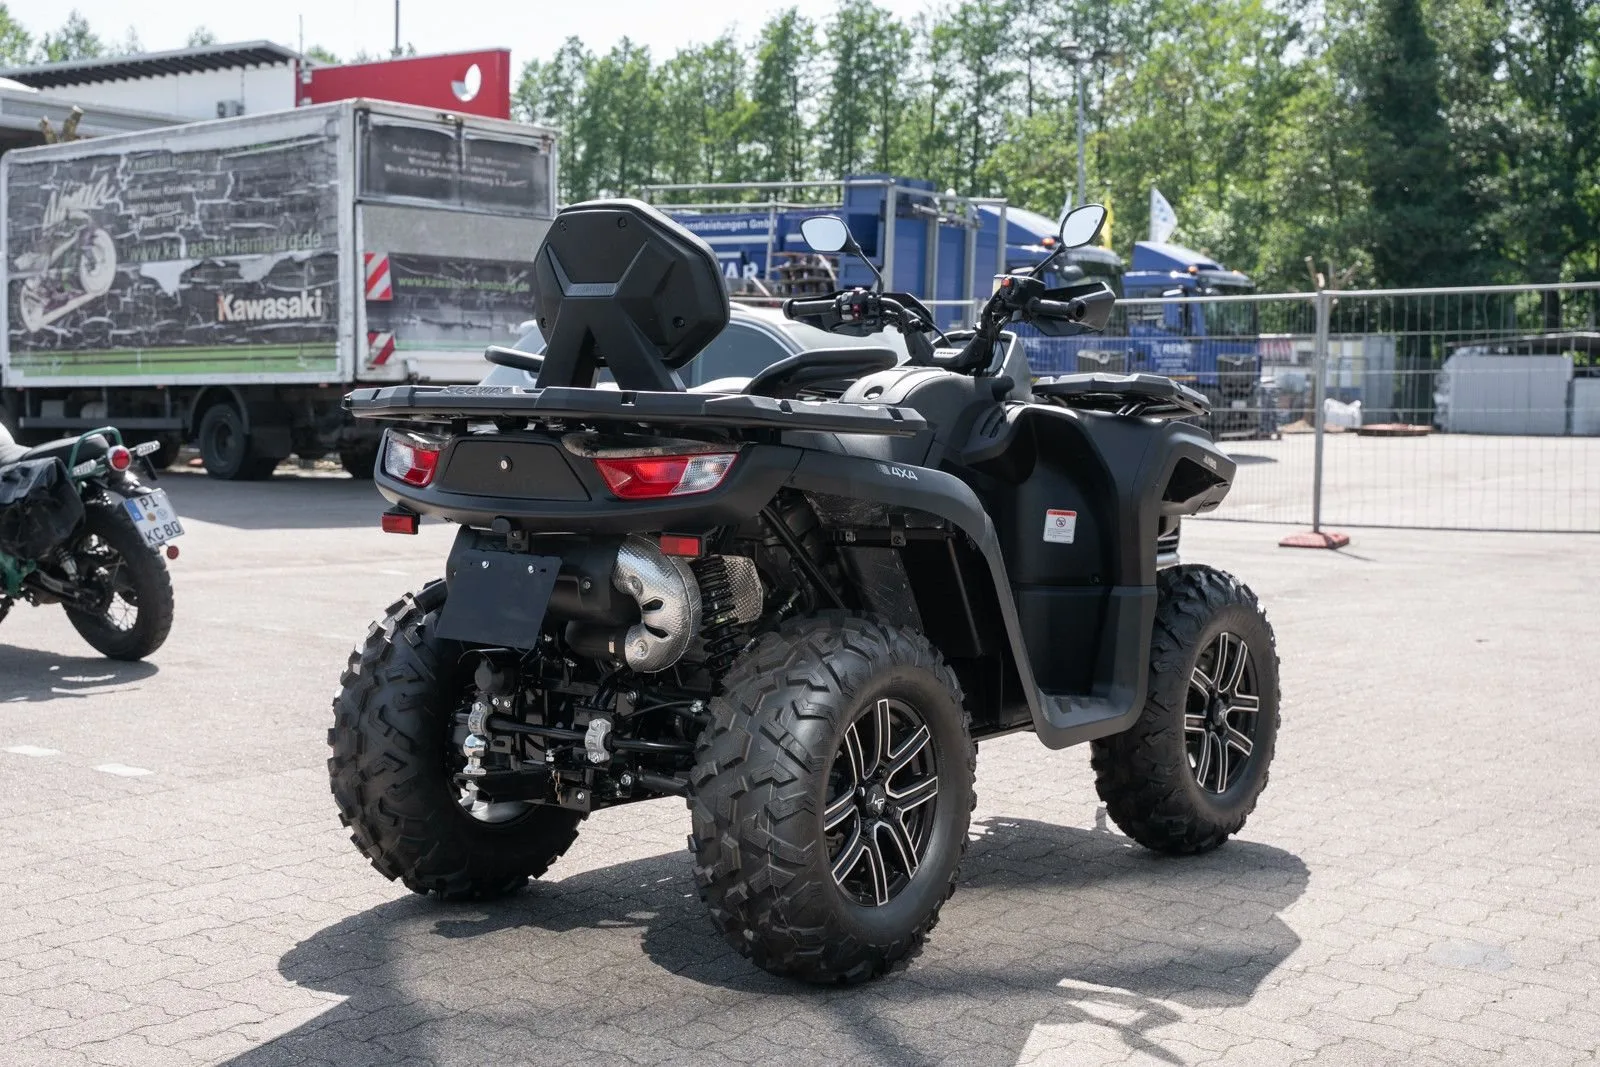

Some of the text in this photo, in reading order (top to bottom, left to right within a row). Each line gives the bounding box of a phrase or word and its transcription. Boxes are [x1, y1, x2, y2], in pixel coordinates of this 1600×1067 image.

[720, 262, 759, 280] AR
[217, 289, 322, 321] Kawasaki
[139, 495, 159, 510] PI
[144, 527, 164, 543] KC
